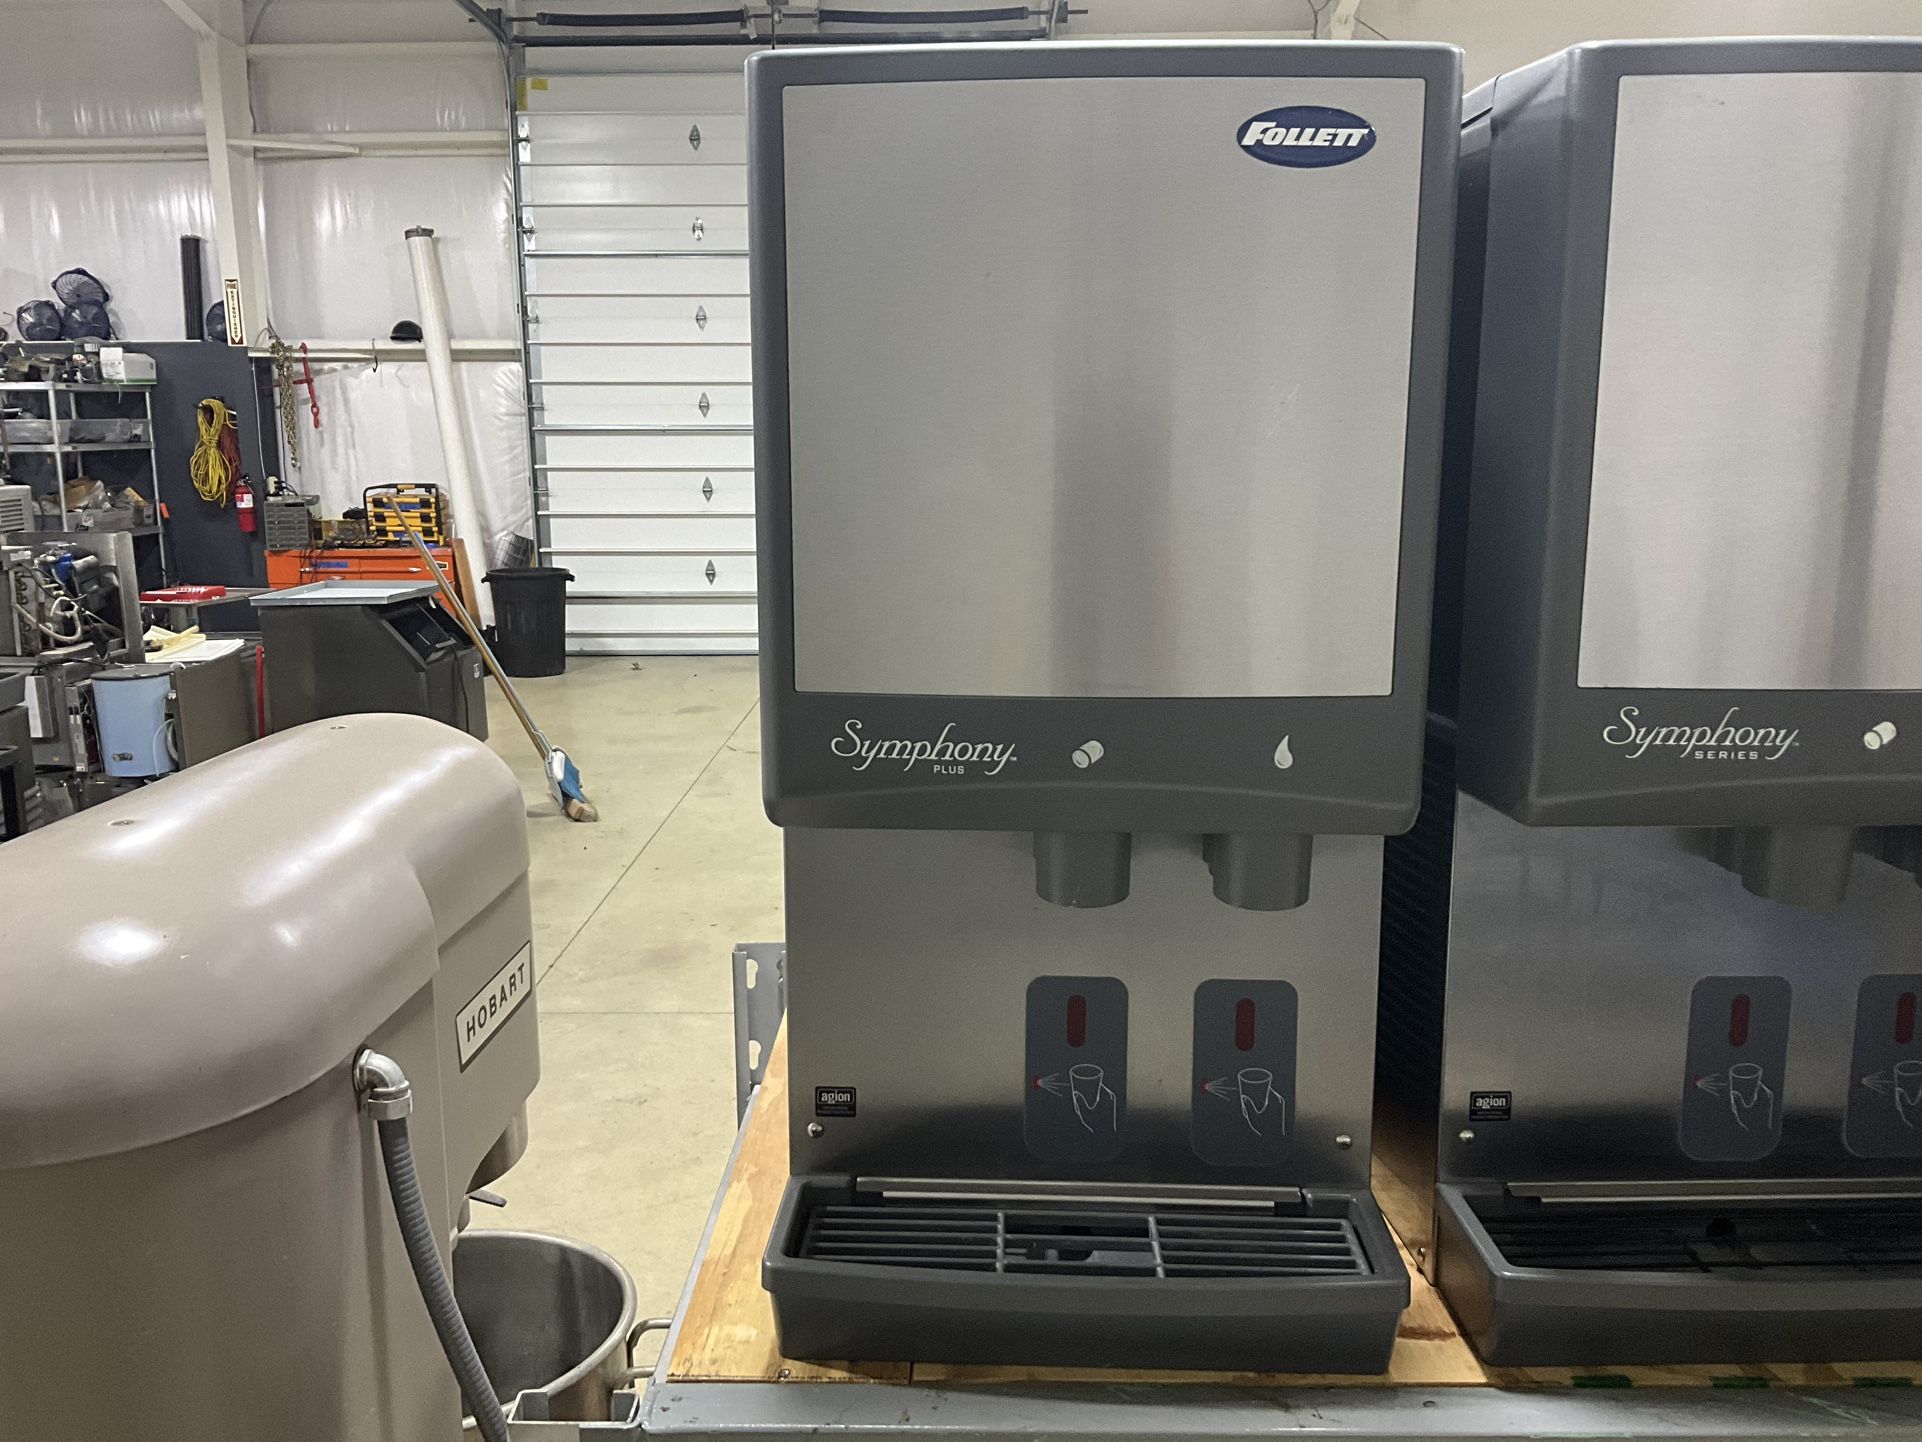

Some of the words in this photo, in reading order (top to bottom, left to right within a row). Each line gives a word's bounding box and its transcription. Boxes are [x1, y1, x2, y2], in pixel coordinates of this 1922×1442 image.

[1241, 121, 1369, 147] FOLLETT
[230, 290, 238, 338] EXTINGUISHER
[1694, 750, 1758, 760] SERIES
[933, 765, 965, 774] PLUS
[466, 962, 525, 1043] HOBART
[821, 1090, 851, 1104] agion
[1475, 1095, 1506, 1109] agion
